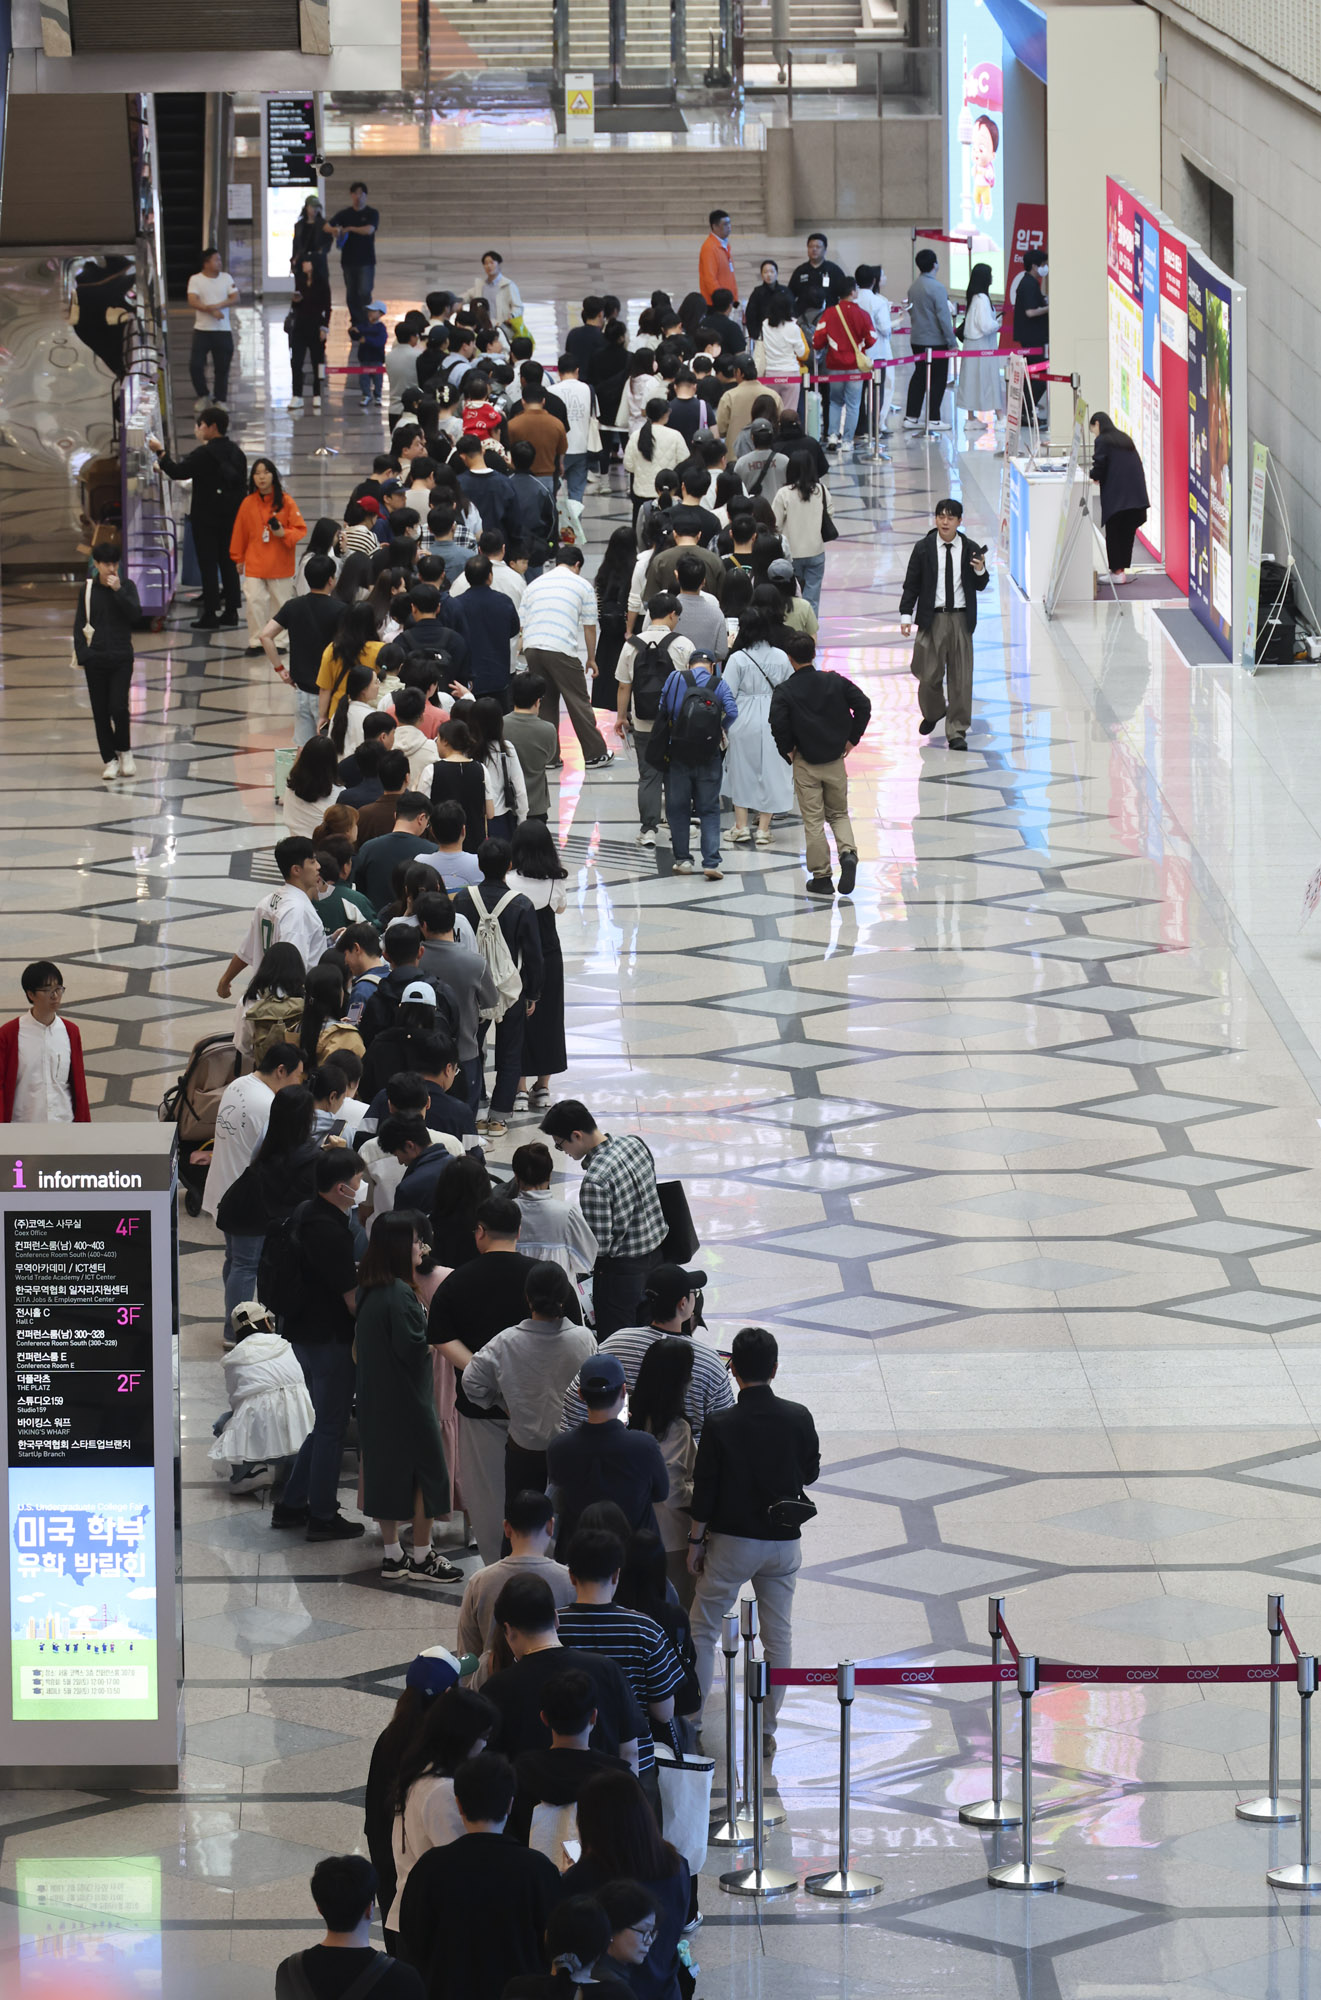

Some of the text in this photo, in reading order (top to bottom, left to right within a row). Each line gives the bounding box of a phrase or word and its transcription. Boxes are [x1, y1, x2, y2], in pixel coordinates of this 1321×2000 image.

[1016, 229, 1043, 250] 입구
[38, 1170, 142, 1189] information
[14, 1219, 81, 1229] (주)코엑스 사무실
[116, 1218, 140, 1236] 4F
[15, 1241, 104, 1251] 컨퍼런스룸(남) 400~403
[15, 1264, 106, 1273] 무역아카데미 / ICT센터
[53, 1274, 80, 1282] Academy
[16, 1285, 128, 1295] 한국무역협회 일자리지원센터
[16, 1308, 50, 1318] 전시홀 C
[117, 1307, 140, 1325] 3F
[16, 1330, 104, 1339] 컨퍼런스룸(남) 300~328
[17, 1352, 67, 1361] 컨퍼런스룸 E
[17, 1375, 50, 1384] 더플라츠
[117, 1374, 141, 1392] 2F
[17, 1397, 63, 1406] 스튜디오159
[18, 1418, 71, 1427] 바이킹스 워프
[18, 1440, 131, 1450] 한국무역협회 스타트업브랜치
[18, 1503, 33, 1511] U.S.
[35, 1503, 95, 1512] Undergraduate
[97, 1503, 128, 1512] College
[19, 1516, 146, 1547] 미국 학부
[18, 1552, 146, 1578] 유학 박람회
[902, 1669, 935, 1681] coex
[1066, 1667, 1099, 1679] coex
[1127, 1668, 1159, 1680] coex
[1187, 1667, 1219, 1679] coex
[1247, 1666, 1279, 1678] coex
